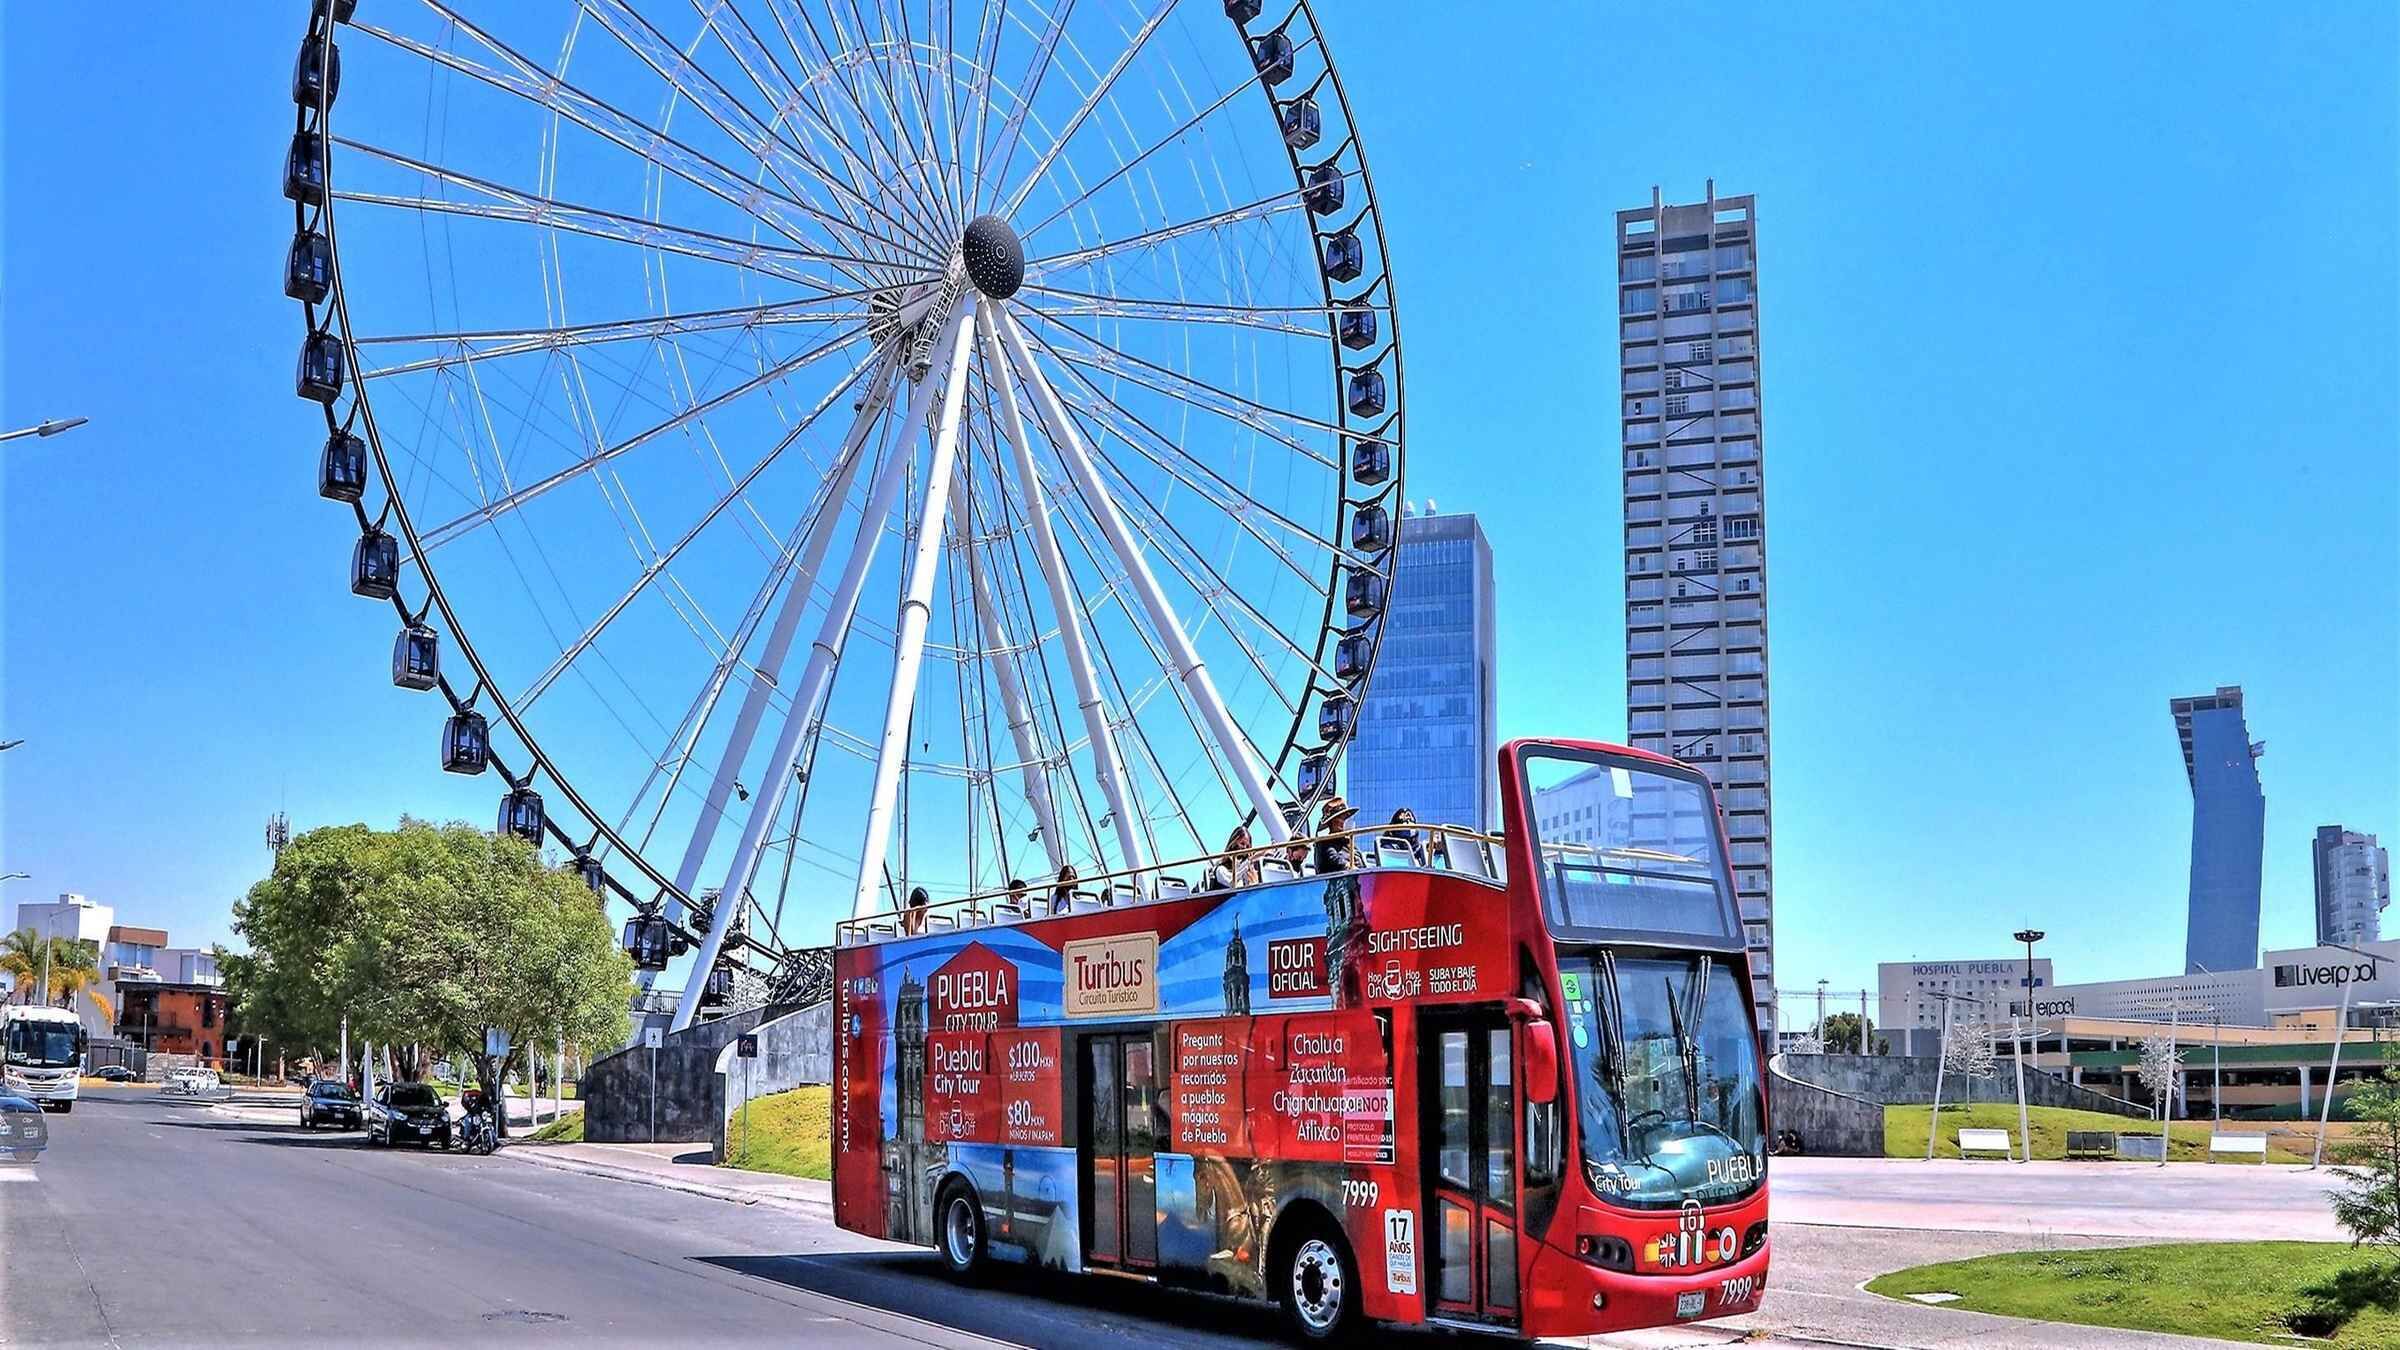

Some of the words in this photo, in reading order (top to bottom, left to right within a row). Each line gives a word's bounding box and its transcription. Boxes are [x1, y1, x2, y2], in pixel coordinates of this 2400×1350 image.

[1368, 924, 1462, 953] SIGHTSEEING
[1271, 943, 1314, 970] TOUR
[1074, 950, 1143, 990] Turibus
[1368, 971, 1382, 984] Hop
[1405, 969, 1419, 980] Hop
[1429, 968, 1450, 980] SUBA
[1450, 968, 1457, 979] Y
[1457, 966, 1476, 978] BAJE
[1913, 964, 1961, 975] HOSPITAL
[1968, 963, 2013, 974] PUEBLA
[2296, 959, 2376, 987] Liverpool
[938, 969, 1009, 1010] PUEBLA
[1273, 971, 1318, 992] OFICIAL
[1368, 983, 1382, 998] On
[1405, 979, 1421, 996] Off
[1430, 981, 1451, 993] TODO
[1452, 980, 1462, 991] EL
[1079, 991, 1106, 1005] Circuito
[2023, 997, 2075, 1017] Lierpool
[945, 1013, 968, 1033] CITY
[967, 1011, 998, 1032] TOUR
[1294, 1032, 1343, 1054] Cholua
[842, 977, 850, 1153] turibus.com.mx
[934, 1040, 982, 1071] Puebla
[1183, 1055, 1198, 1069] por
[934, 1074, 955, 1098] City
[955, 1074, 980, 1094] Tour
[1181, 1071, 1226, 1085] recorridos
[1181, 1093, 1187, 1104] a
[1190, 1089, 1225, 1107] pueblos
[1008, 1100, 1031, 1128] $80
[1182, 1109, 1219, 1126] mágicos
[1182, 1129, 1193, 1142] de
[1195, 1128, 1227, 1143] Puebla
[1297, 1120, 1340, 1141] Atlixco
[1707, 1155, 1763, 1184] PUEBLA
[1341, 1180, 1378, 1207] 7999
[1594, 1174, 1617, 1195] City
[1618, 1174, 1641, 1191] Tour
[1390, 1217, 1408, 1241] 17
[1389, 1240, 1411, 1254] AÑOS
[1719, 1276, 1752, 1305] 7999
